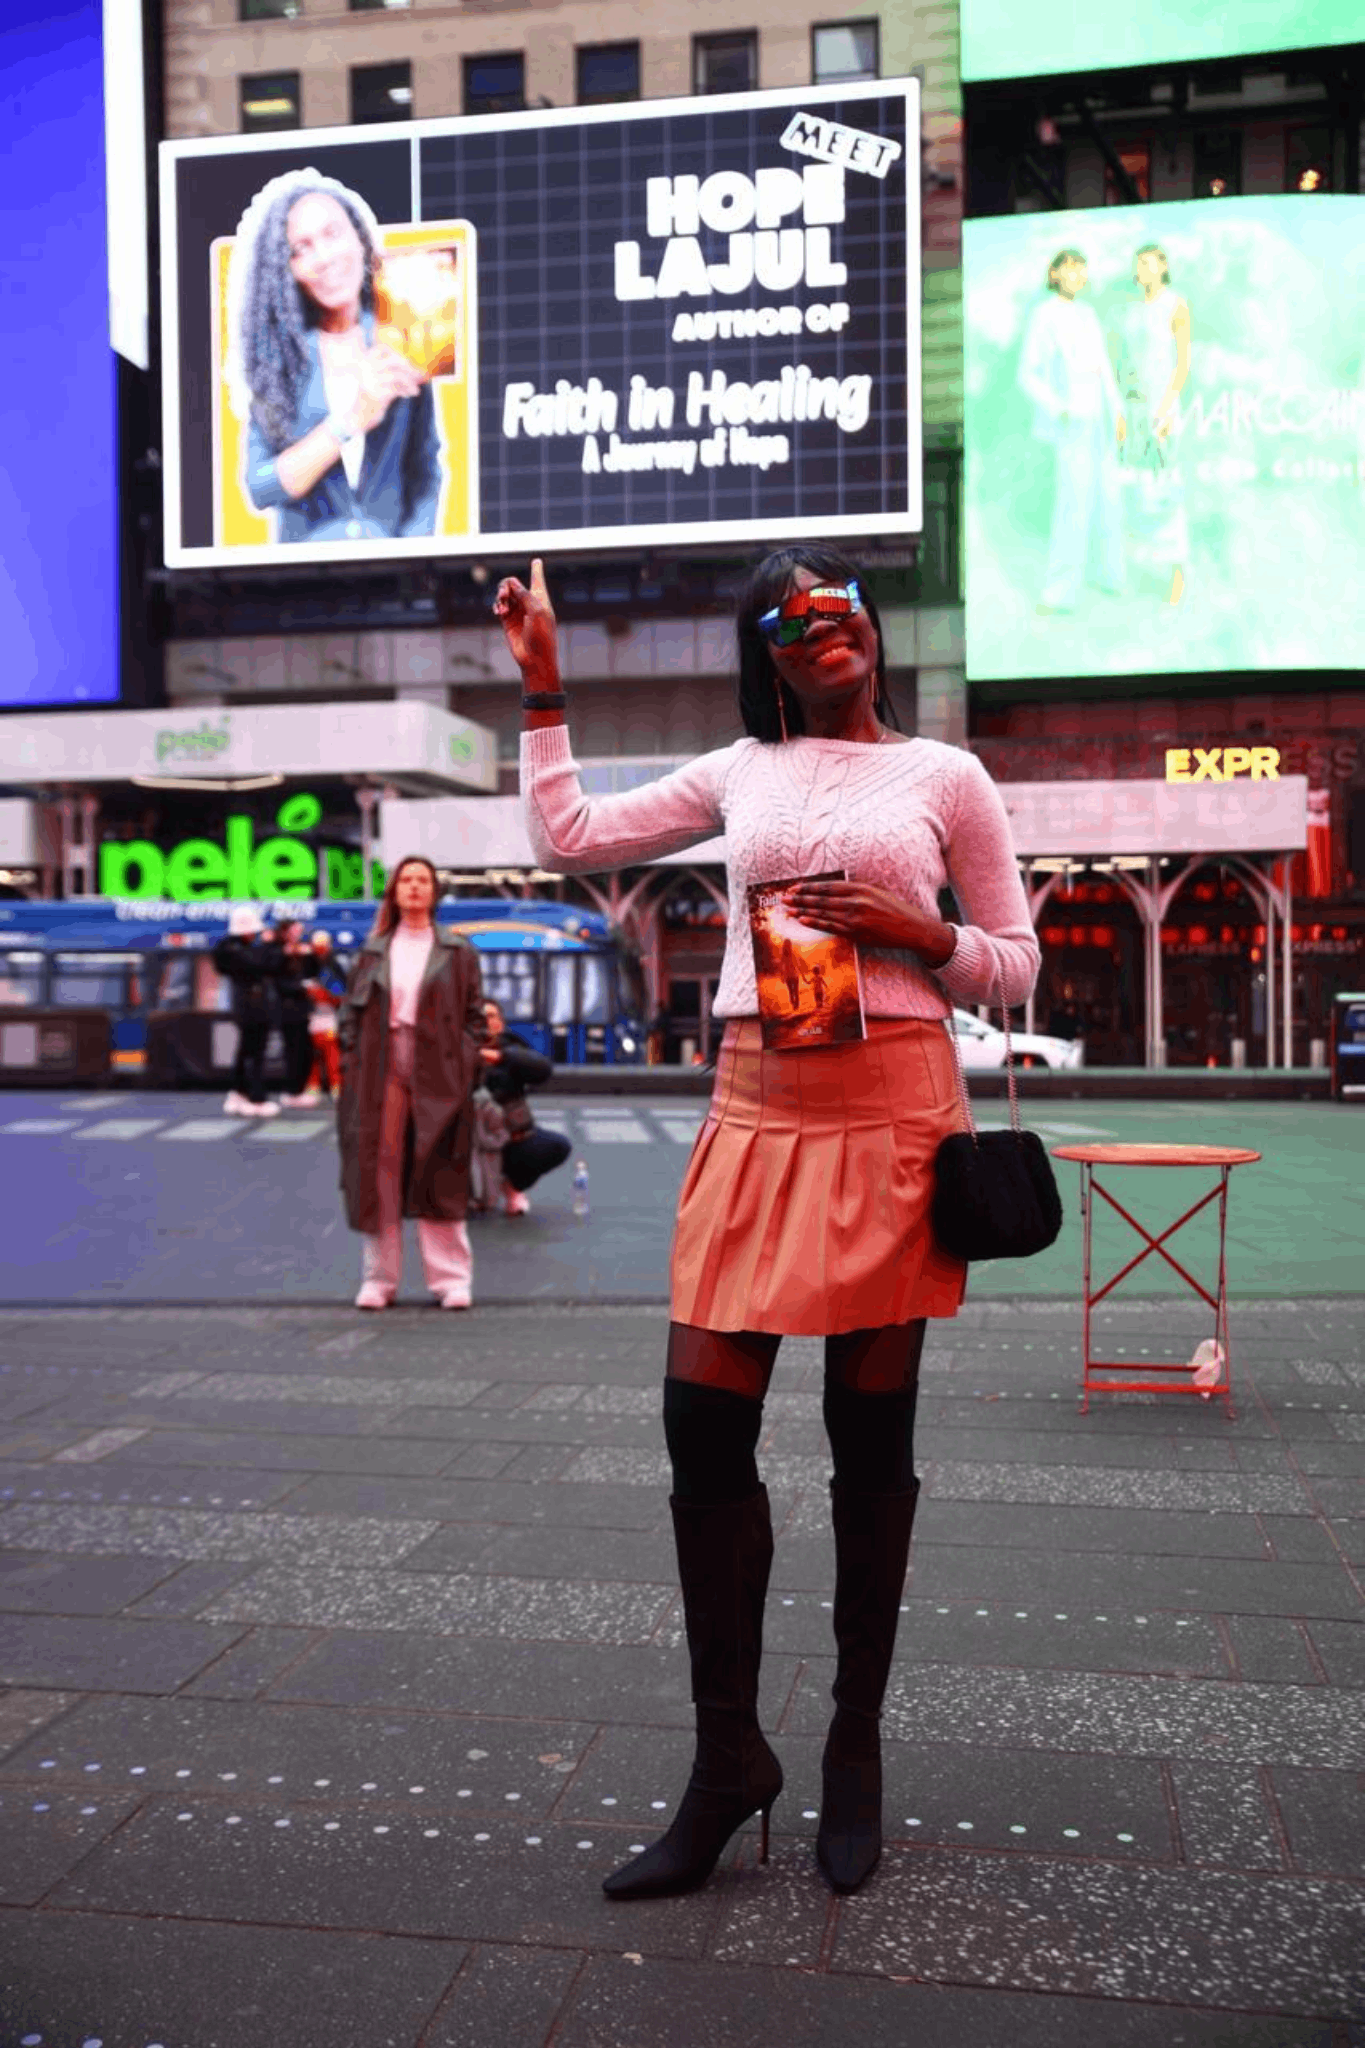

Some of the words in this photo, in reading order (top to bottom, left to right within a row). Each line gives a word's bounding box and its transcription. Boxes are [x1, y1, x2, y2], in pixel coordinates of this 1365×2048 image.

[789, 120, 890, 170] MEET
[646, 163, 846, 237] HOPE
[614, 227, 848, 301] LAJUL
[672, 306, 803, 342] AUTHOR
[805, 303, 850, 334] OF
[503, 378, 618, 438] Faith
[628, 374, 674, 431] in
[686, 364, 872, 432] Healing
[581, 434, 601, 473] A
[603, 433, 697, 475] Journey
[700, 426, 726, 467] of
